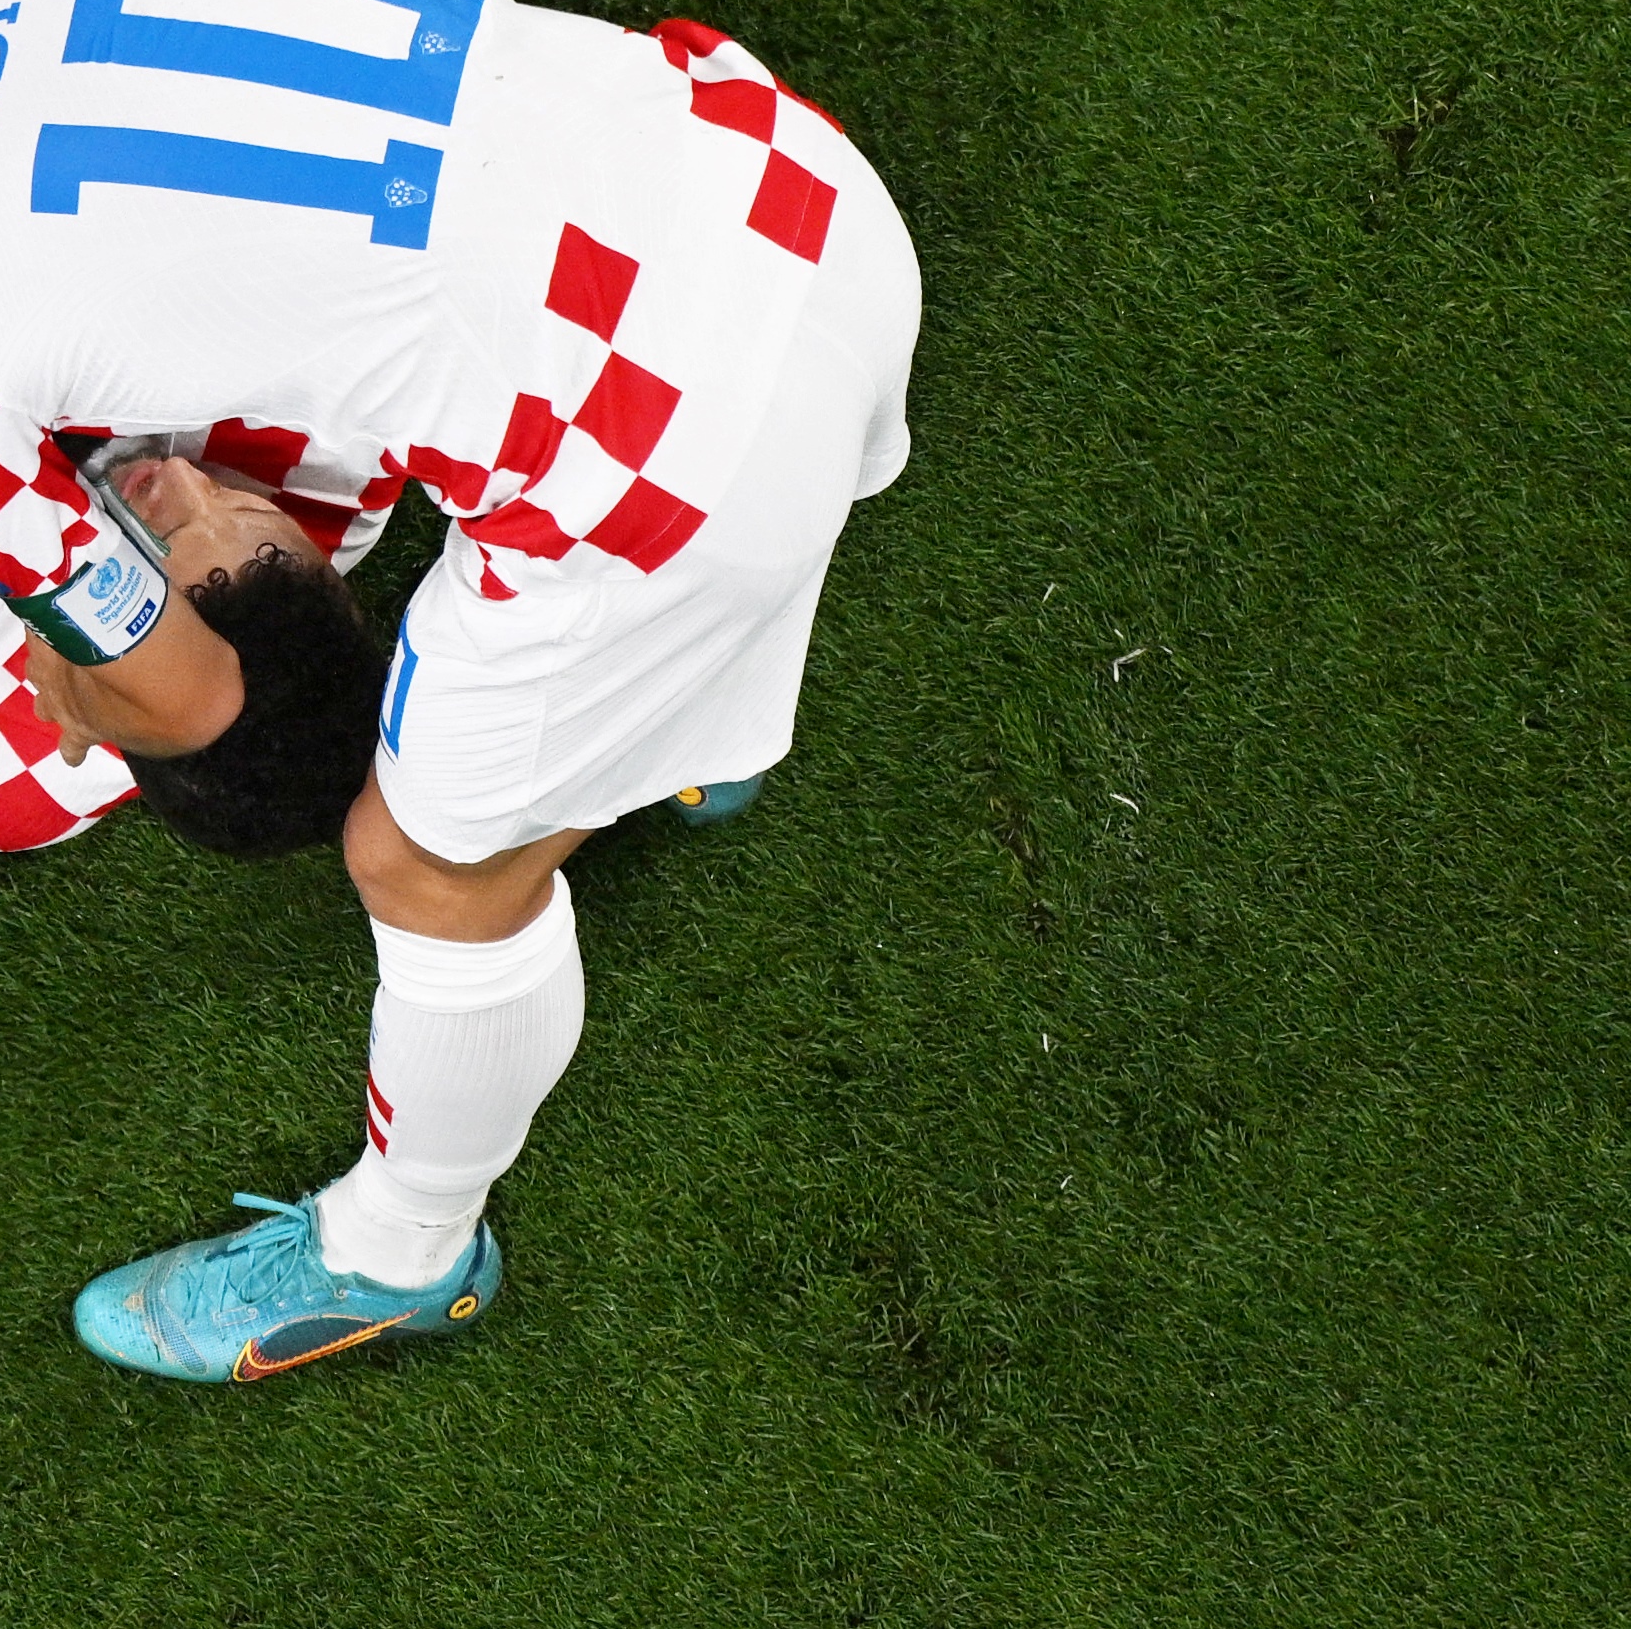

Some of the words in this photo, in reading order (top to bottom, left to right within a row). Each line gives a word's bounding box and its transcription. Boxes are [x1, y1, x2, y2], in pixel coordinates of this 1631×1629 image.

[93, 594, 120, 619] World
[118, 564, 137, 596] Health
[99, 571, 143, 625] Organization
[129, 605, 153, 633] FIFA
